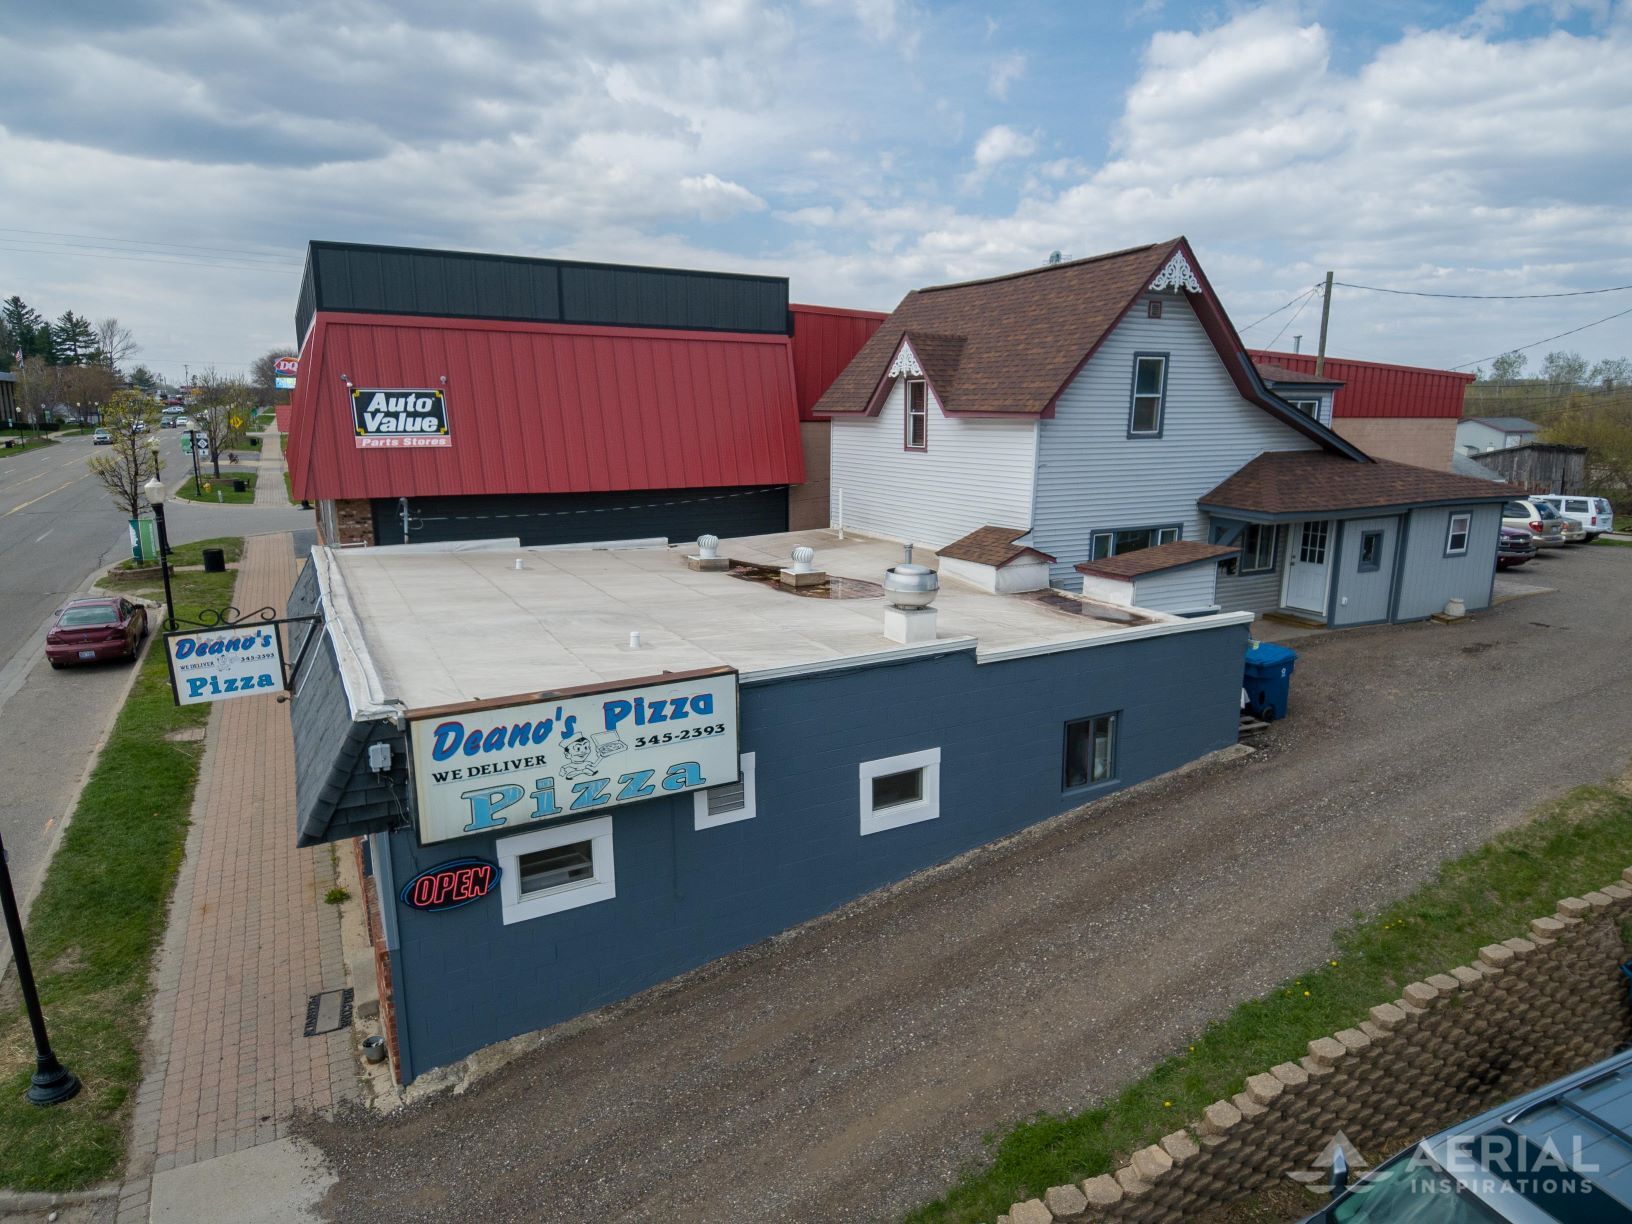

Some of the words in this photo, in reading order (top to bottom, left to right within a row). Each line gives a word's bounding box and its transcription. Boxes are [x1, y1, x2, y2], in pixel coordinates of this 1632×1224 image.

[280, 361, 298, 371] DQ
[366, 392, 433, 412] Auto
[363, 412, 438, 432] Value
[362, 438, 399, 447] Parts
[403, 438, 446, 446] Stores
[175, 630, 272, 660] Deano's
[190, 661, 214, 670] DELIVER
[186, 673, 274, 697] Pizza
[431, 706, 577, 762] Deano's
[603, 693, 713, 730] Pizza
[634, 723, 726, 748] 345-2393
[432, 768, 463, 783] WE
[467, 755, 547, 778] DELIVER
[461, 761, 706, 832] Pizza
[414, 865, 491, 906] OPEN
